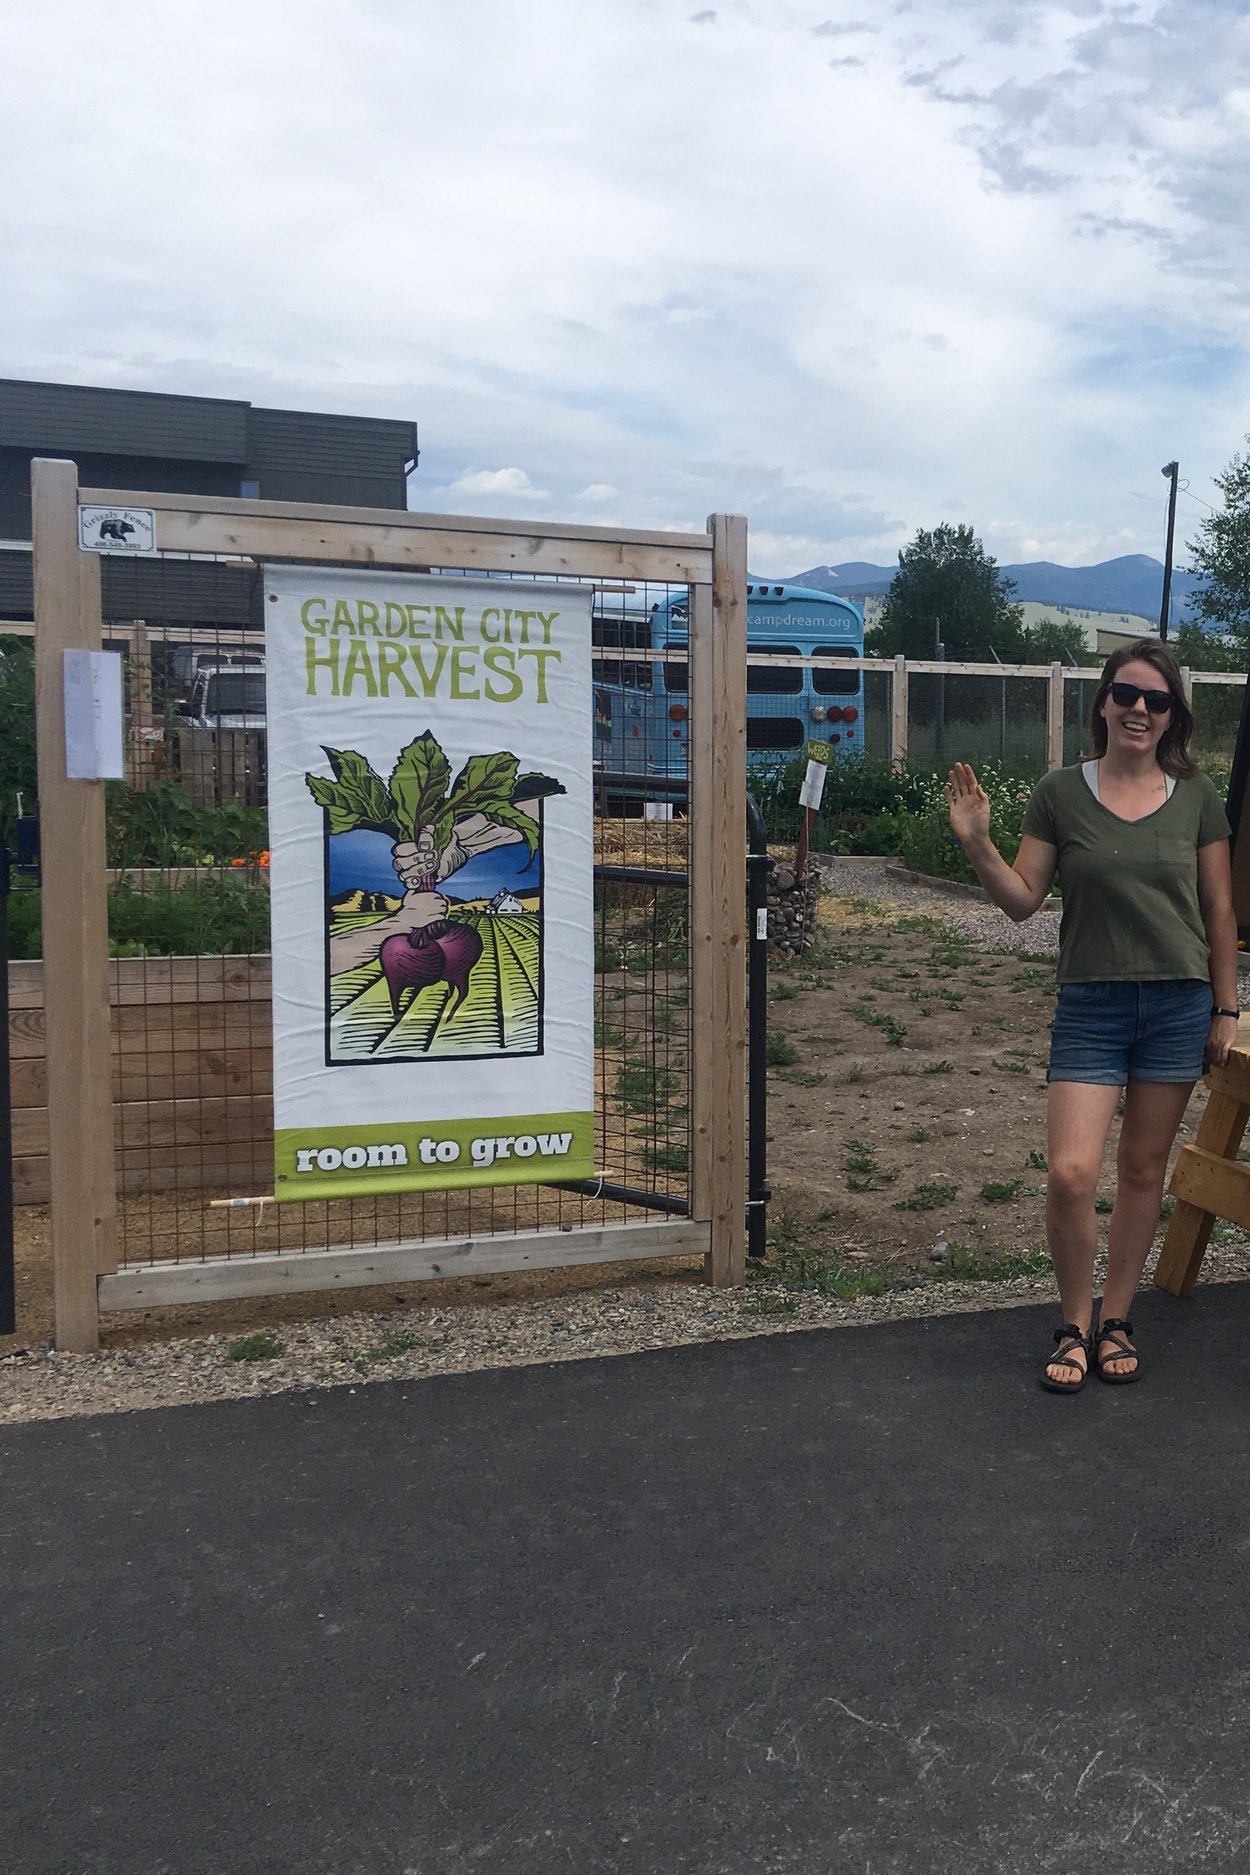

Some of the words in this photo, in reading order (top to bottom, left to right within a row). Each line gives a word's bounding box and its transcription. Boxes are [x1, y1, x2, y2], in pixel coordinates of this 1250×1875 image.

[123, 512, 152, 531] Fence
[301, 598, 466, 641] GARDEN
[480, 608, 560, 644] CITY
[305, 636, 561, 704] HARVEST
[808, 742, 830, 760] WEEDS
[296, 1144, 408, 1172] room
[419, 1138, 460, 1164] to
[471, 1132, 573, 1167] grow
